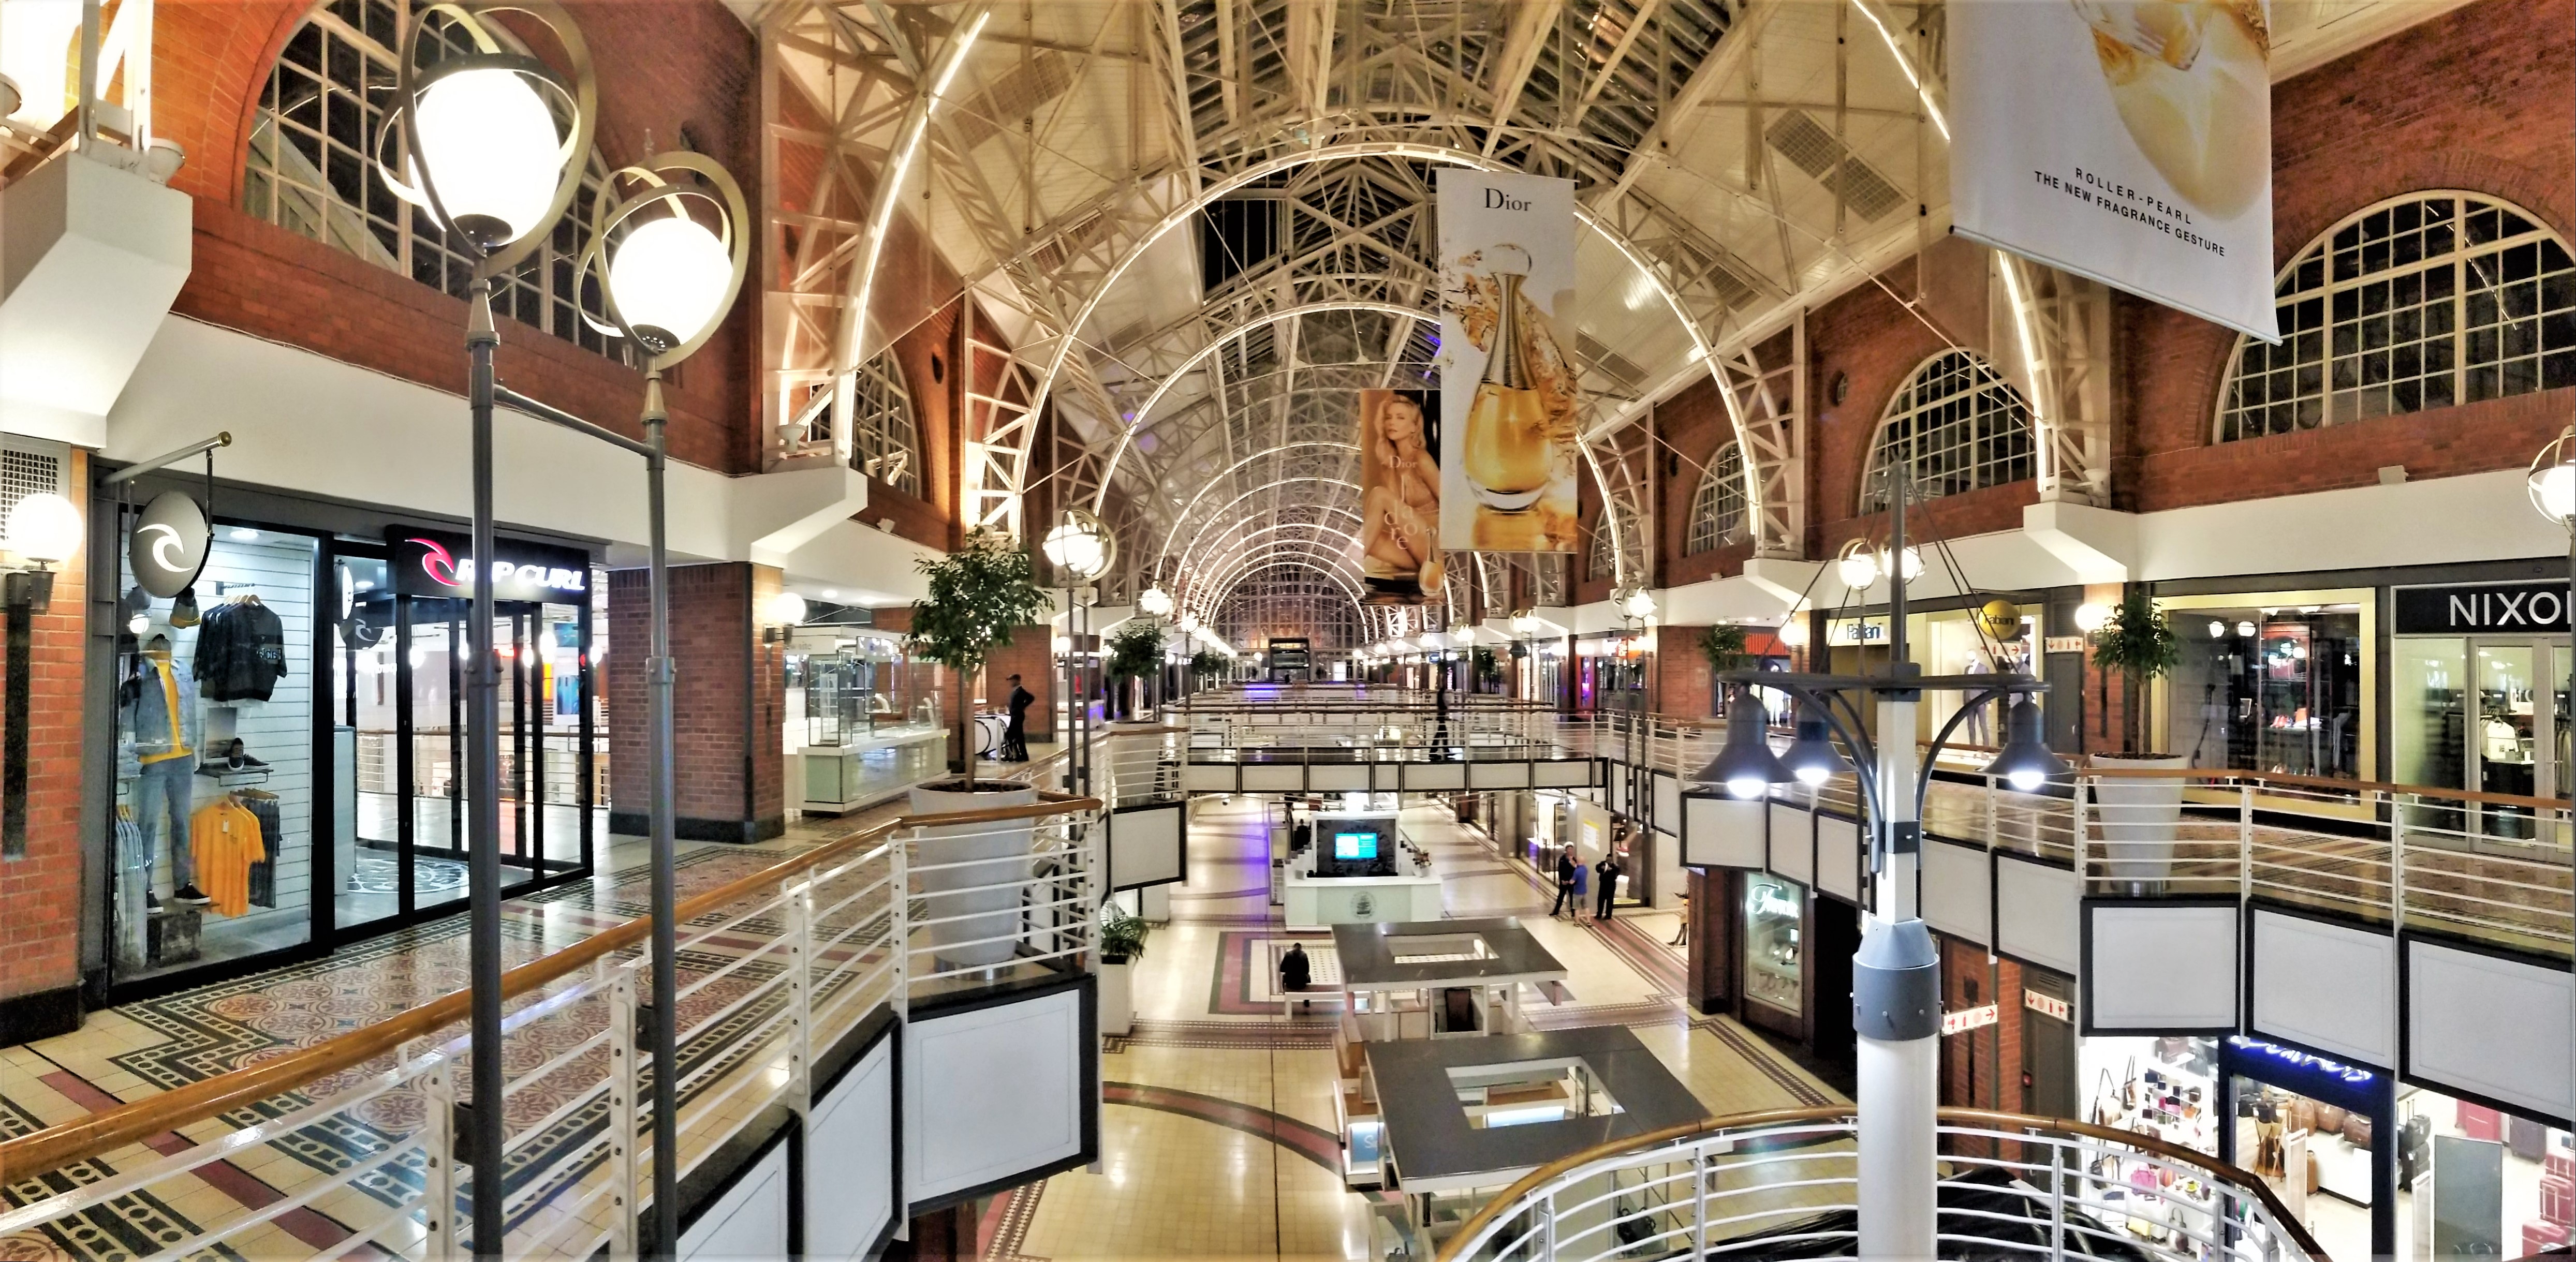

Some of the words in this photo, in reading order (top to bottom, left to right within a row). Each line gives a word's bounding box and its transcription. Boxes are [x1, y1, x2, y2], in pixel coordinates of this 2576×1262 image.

[1484, 187, 1532, 211] Dior
[2075, 167, 2191, 225] ROLLER-PEARL
[2035, 171, 2059, 189] THE
[2065, 182, 2091, 202] NEW
[2097, 196, 2170, 234] FRAGRANCE
[2175, 228, 2225, 257] GESTURE
[1389, 455, 1417, 468] Dior
[455, 558, 516, 583] RP
[515, 565, 585, 590] CURL
[2450, 590, 2572, 627] NIXO
